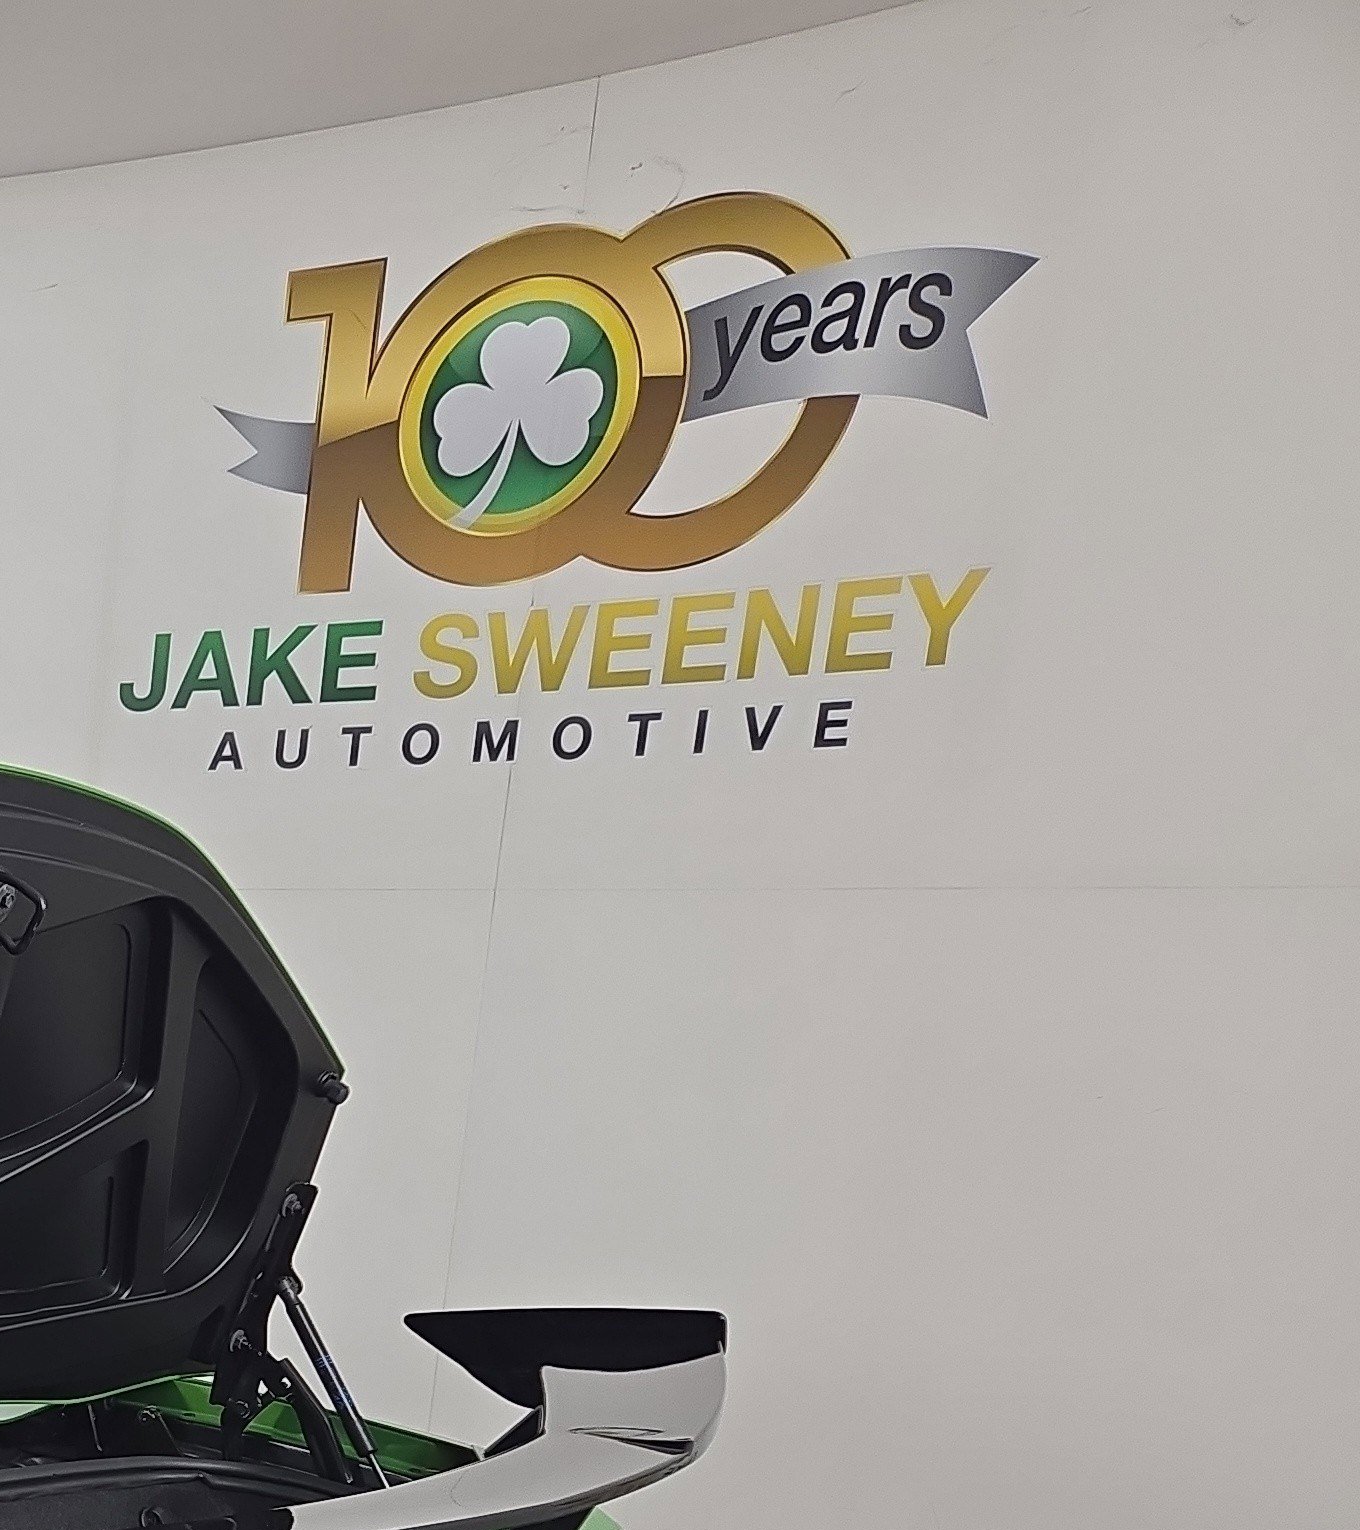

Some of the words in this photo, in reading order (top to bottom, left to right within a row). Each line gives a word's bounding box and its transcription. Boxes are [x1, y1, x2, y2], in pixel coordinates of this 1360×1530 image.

[284, 190, 861, 594] 100
[701, 270, 953, 401] years
[118, 618, 384, 714] JAKE
[412, 566, 992, 700] SWEENEY
[207, 699, 853, 773] AUTOMOTIVE
